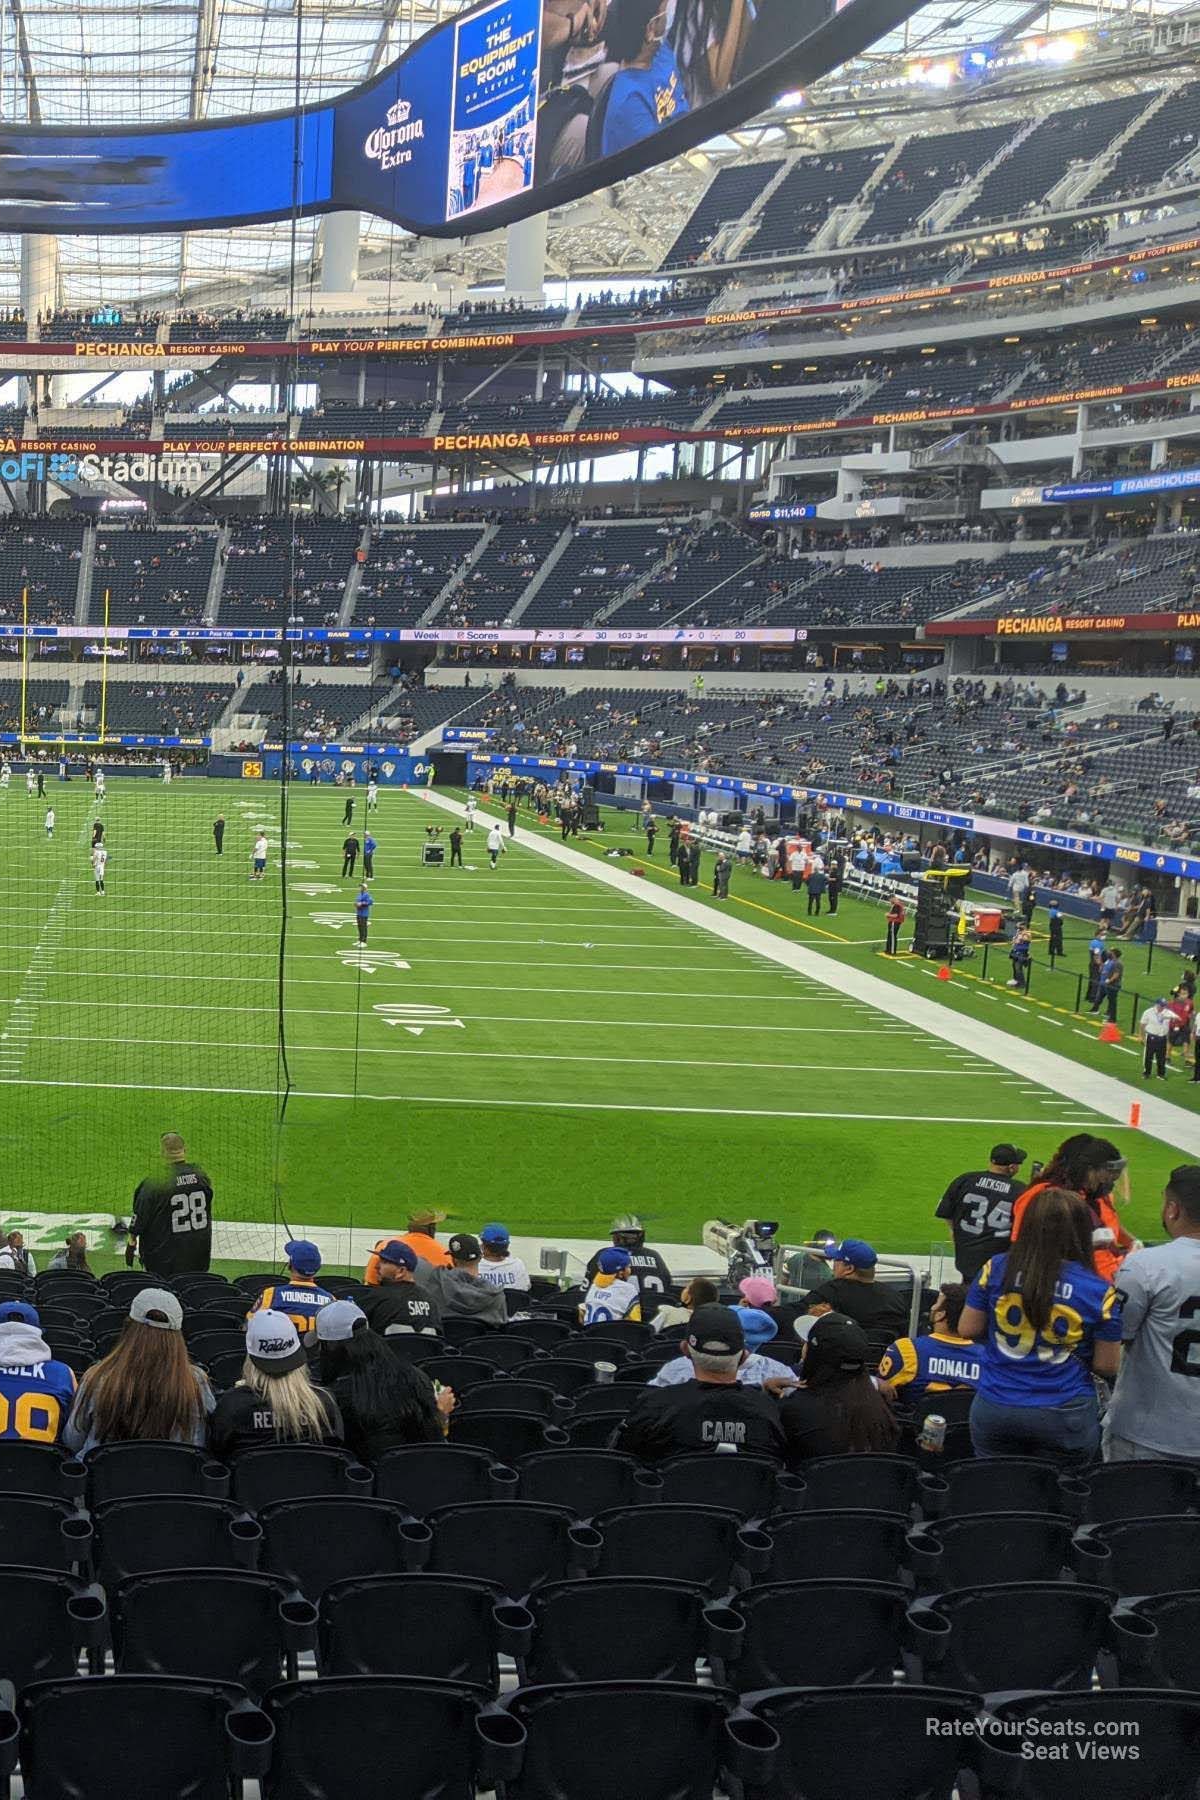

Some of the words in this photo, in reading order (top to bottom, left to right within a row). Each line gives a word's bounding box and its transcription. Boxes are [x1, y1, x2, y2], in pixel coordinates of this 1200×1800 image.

[486, 27, 511, 49] THE
[460, 30, 535, 78] EQUIPMENT
[477, 56, 516, 86] ROOM
[364, 119, 423, 160] Corona
[380, 149, 412, 170] Extra
[989, 272, 1046, 288] PECHANGA
[876, 294, 904, 304] PERFECT
[904, 287, 951, 300] COMBINATION
[705, 311, 756, 324] PECHANGA
[75, 343, 166, 356] PECHANGA
[170, 345, 206, 353] RESORT
[210, 345, 245, 353] CASINO
[311, 342, 340, 352] PLAY
[344, 342, 374, 351] YOUR
[377, 340, 428, 350] PERFECT
[431, 334, 514, 349] COMBINATION
[1010, 401, 1027, 409] PLAY
[1046, 393, 1074, 404] PERFECT
[1075, 386, 1123, 400] COMBINATION
[873, 411, 926, 425] PECHANGA
[762, 425, 791, 433] PERFECT
[792, 421, 837, 431] COMBINATION
[21, 442, 57, 450] RESORT
[61, 442, 97, 450] CASINO
[163, 442, 191, 450] PLAY
[195, 442, 225, 450] YOUR
[228, 441, 279, 450] PERFECT
[281, 440, 365, 450] COMBINATION
[434, 433, 530, 450] PECHANGA
[535, 434, 576, 443] RESORT
[579, 432, 619, 441] CASINO
[81, 452, 202, 480] Stadium
[1121, 471, 1200, 490] #RAMSHOUSE
[774, 507, 806, 518] $11,140
[997, 616, 1063, 634] PECHANGA
[1065, 619, 1095, 630] RESORT
[1096, 618, 1125, 629] CASINO
[413, 631, 440, 640] Week
[466, 631, 499, 640] Scores
[595, 631, 607, 639] 30
[734, 631, 746, 639] 20
[459, 731, 487, 739] RAMS
[244, 763, 260, 775] 25
[1115, 848, 1140, 862] RAMS
[335, 950, 412, 969] 20
[372, 1003, 466, 1028] 10
[176, 1173, 198, 1186] JACOBS
[975, 1176, 1011, 1194] JACKSON
[170, 1190, 208, 1233] 28
[959, 1192, 1012, 1237] 34
[627, 1254, 658, 1269] TABLER
[408, 1300, 430, 1317] SAPP
[994, 1292, 1084, 1365] 99
[258, 1337, 295, 1354] Raiders
[928, 1357, 980, 1381] DONALD
[701, 1420, 746, 1443] CARR
